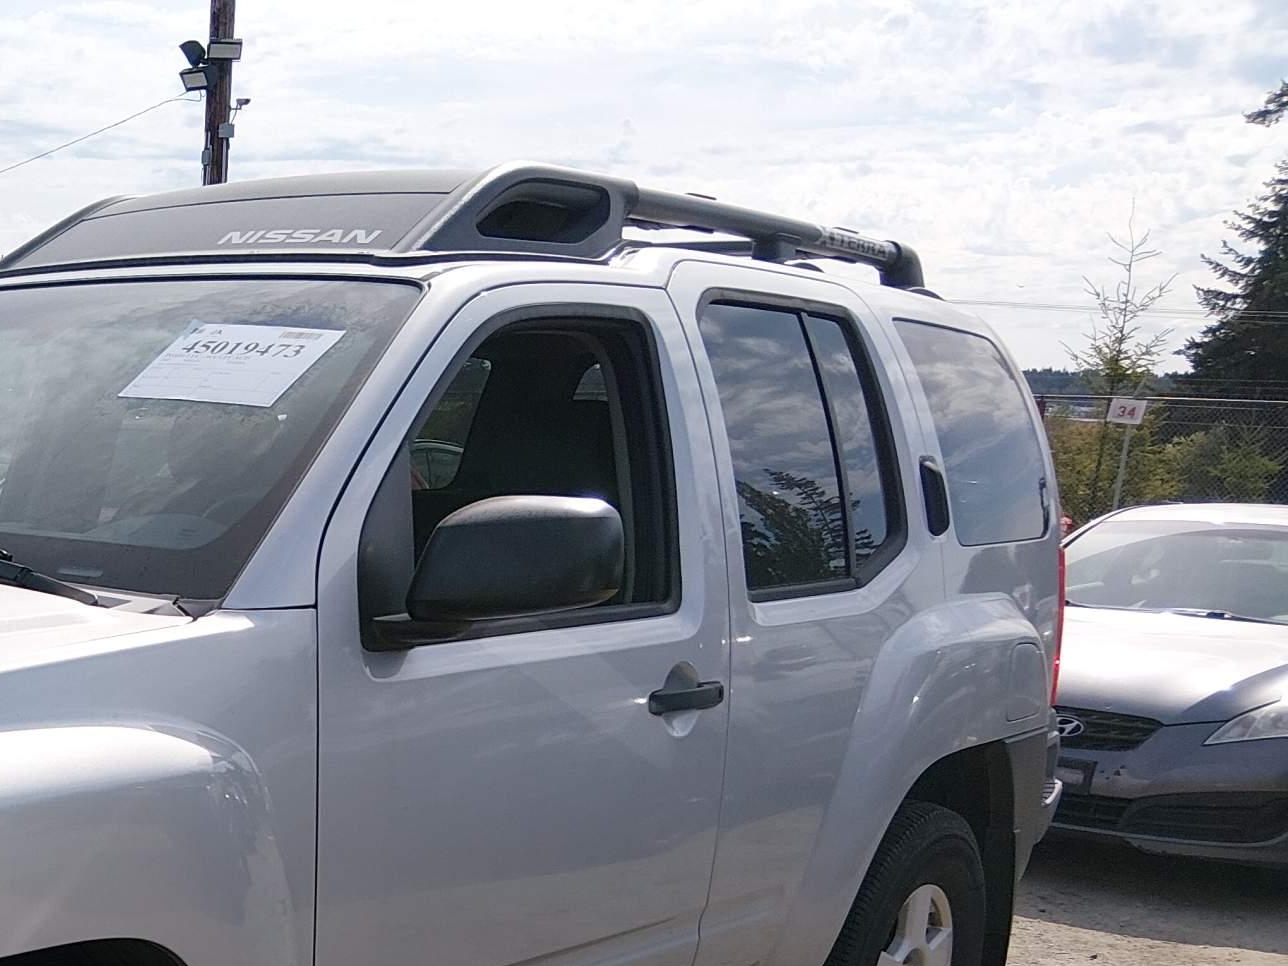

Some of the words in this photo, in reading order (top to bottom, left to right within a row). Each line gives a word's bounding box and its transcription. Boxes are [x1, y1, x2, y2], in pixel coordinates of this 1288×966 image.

[217, 229, 383, 245] NISSAN
[182, 339, 306, 358] 45019473
[1117, 405, 1137, 417] 34
